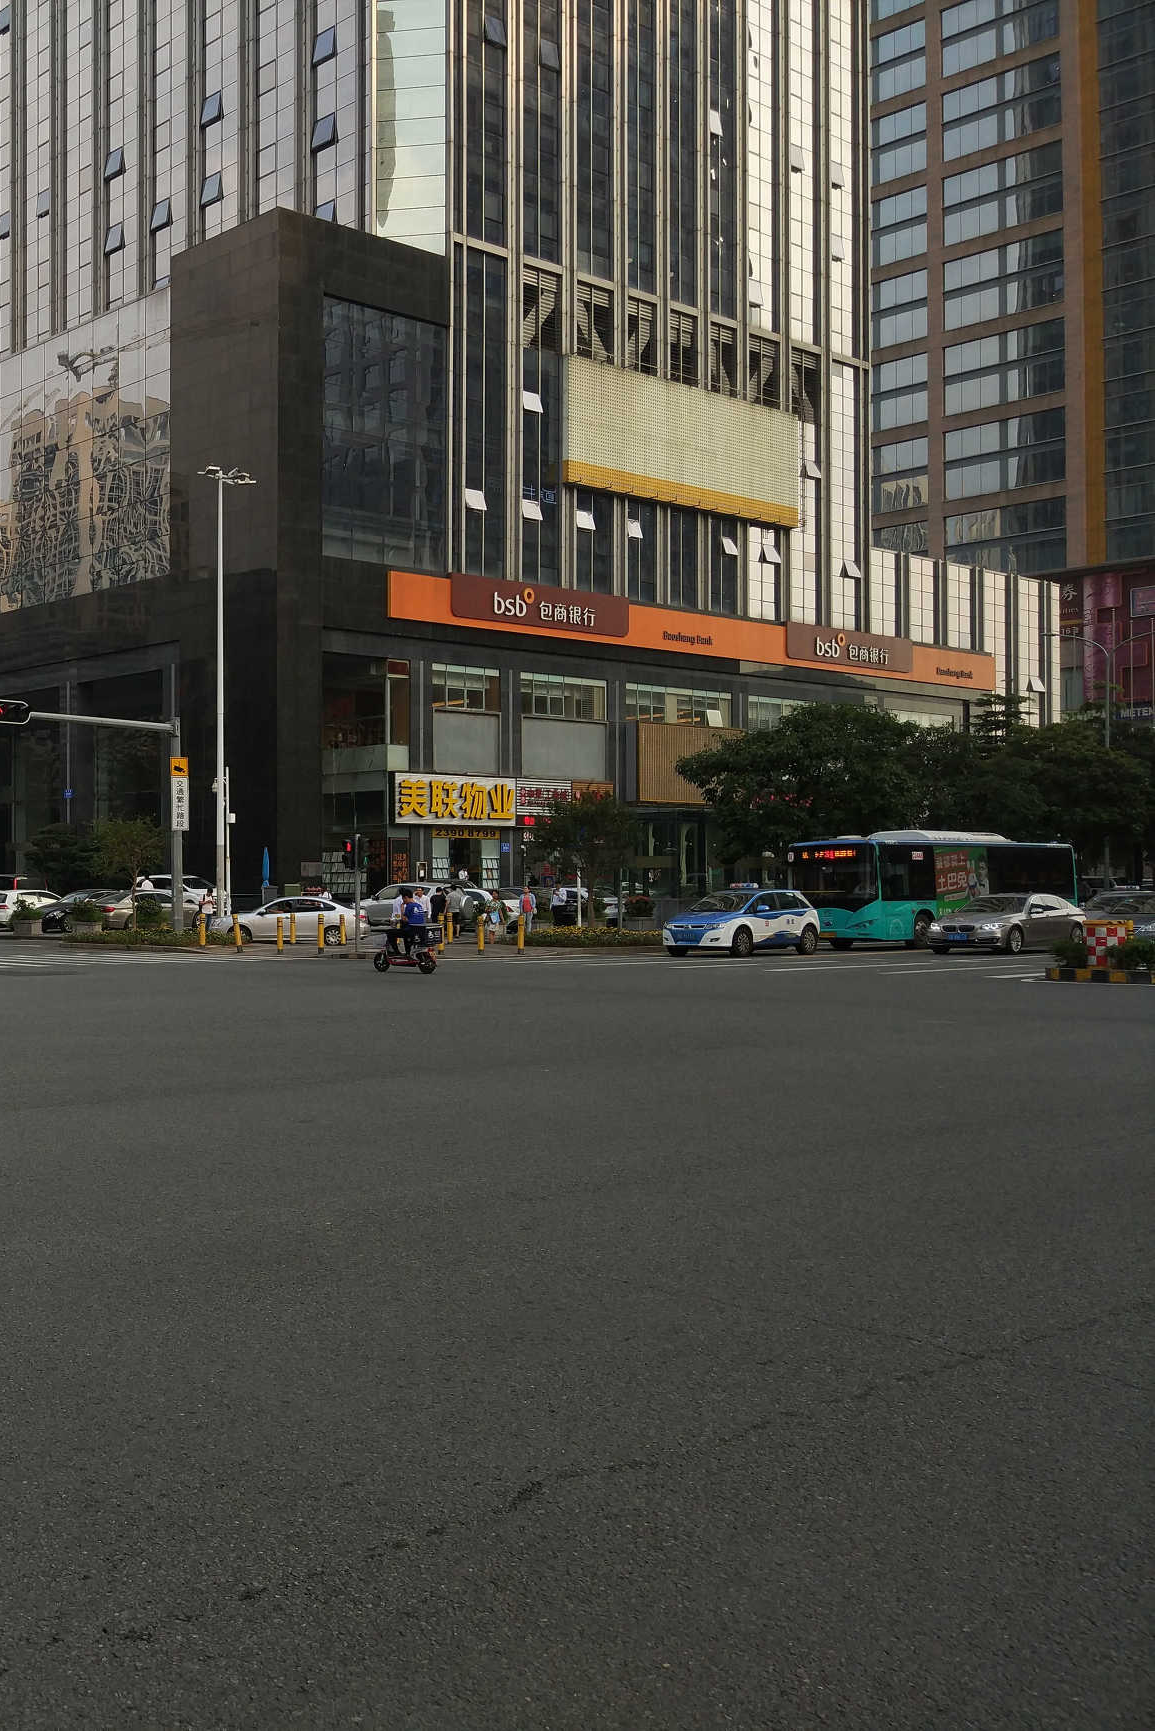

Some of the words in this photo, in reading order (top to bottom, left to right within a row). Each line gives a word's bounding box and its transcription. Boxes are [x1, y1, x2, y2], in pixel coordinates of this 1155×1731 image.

[494, 591, 527, 617] bsb
[539, 601, 596, 627] 包商银行
[696, 634, 713, 646] Bank
[816, 636, 840, 658] bsb
[849, 643, 889, 665] 包商银行
[175, 780, 185, 828] 交通繁忙路段
[398, 779, 515, 820] 美联物业
[436, 828, 464, 837] 2390
